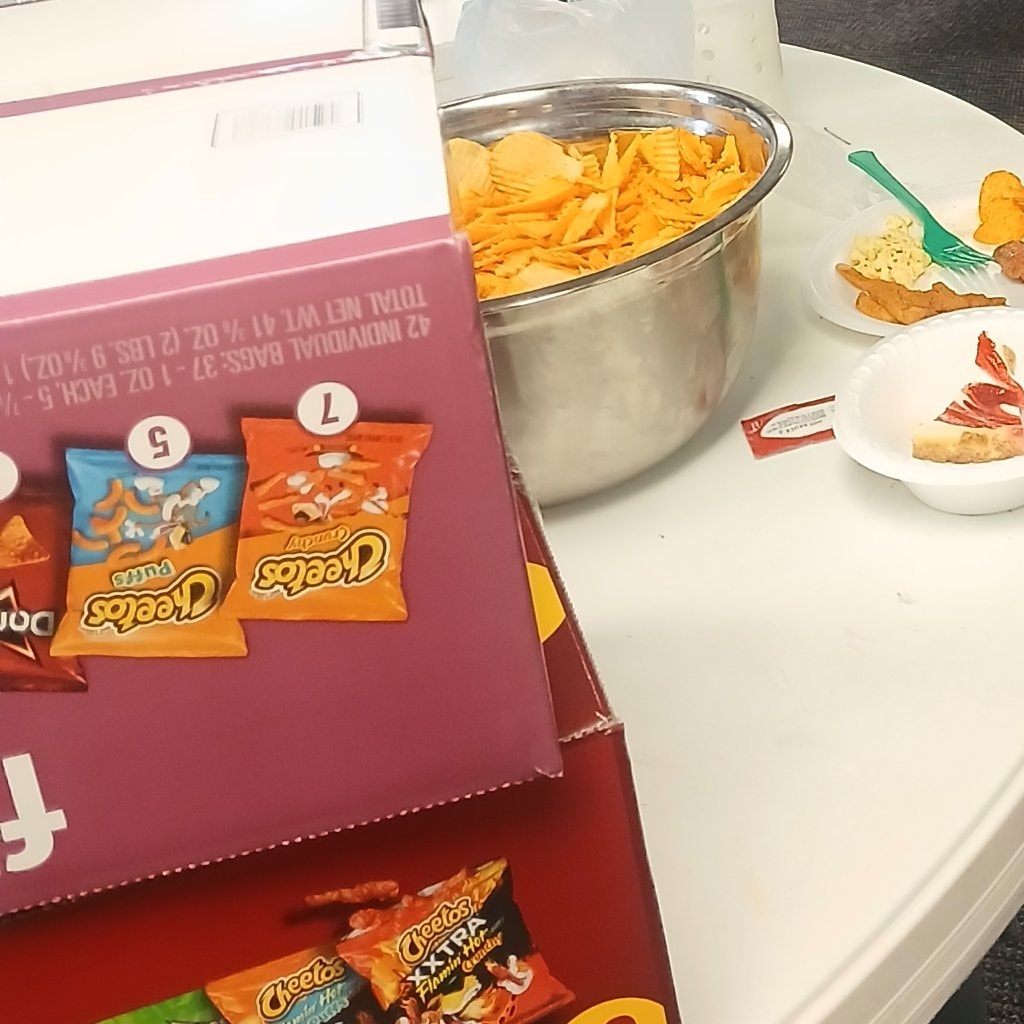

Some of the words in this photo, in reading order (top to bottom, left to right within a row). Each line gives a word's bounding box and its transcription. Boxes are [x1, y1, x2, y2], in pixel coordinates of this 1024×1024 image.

[325, 296, 363, 325] NET
[366, 283, 428, 316] TOTAL
[252, 313, 276, 339] 41
[280, 304, 321, 333] WT.
[406, 315, 431, 339] 42
[109, 335, 155, 364] LBS.
[159, 326, 181, 357] (2
[183, 323, 219, 350] OZ.
[289, 318, 403, 362] INDIVIDUAL
[91, 344, 107, 369] 9
[193, 354, 219, 381] 37
[220, 341, 285, 374] BAGS:
[120, 366, 155, 394] OZ.
[161, 363, 173, 387] 1
[38, 385, 54, 410] 5
[319, 391, 341, 426] 7
[148, 425, 171, 460] 5
[285, 525, 351, 552] Crunchy
[112, 559, 176, 587] Puffs
[252, 530, 389, 597] Cheetos
[83, 569, 221, 635] Cheetos
[398, 897, 473, 965] Cheetos
[406, 916, 488, 987] XXTRA
[415, 950, 462, 1004] Flamin'
[463, 928, 488, 958] Hot
[461, 932, 503, 973] Crunchy
[258, 957, 346, 1022] Cheetos
[318, 981, 346, 1008] Hot
